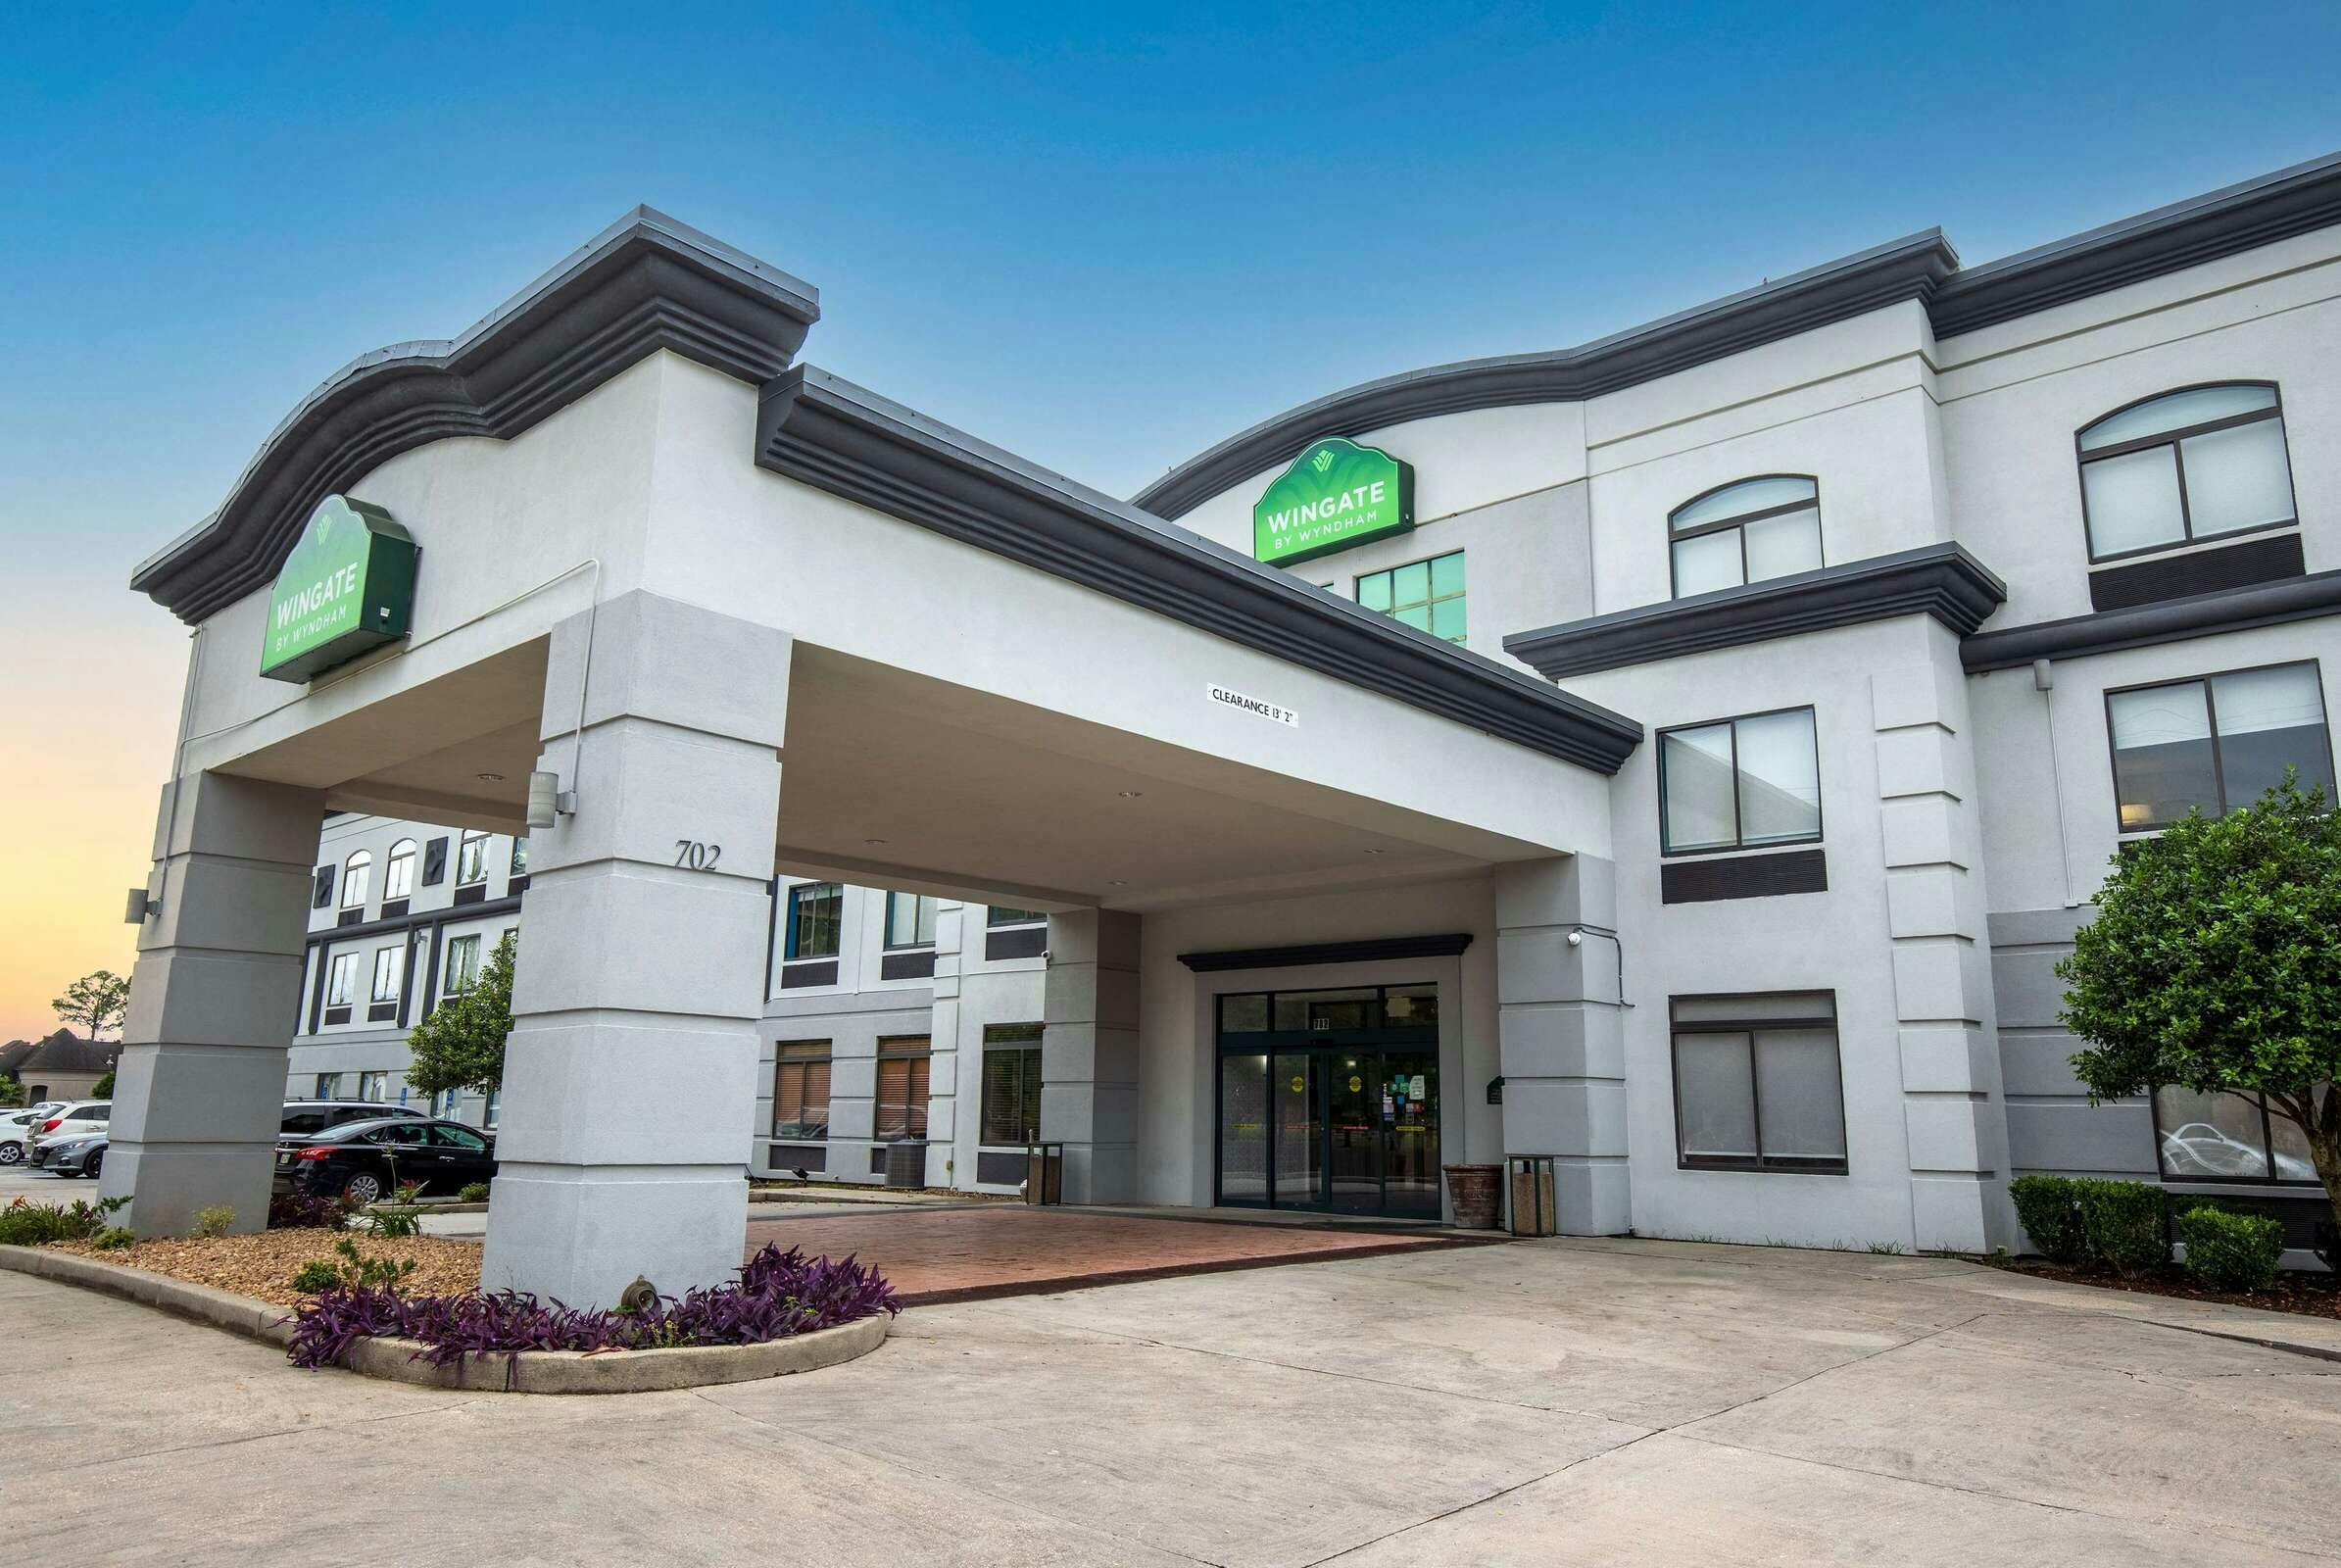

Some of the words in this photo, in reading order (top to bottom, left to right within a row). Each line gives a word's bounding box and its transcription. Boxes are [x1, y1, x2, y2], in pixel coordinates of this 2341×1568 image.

[1267, 480, 1385, 534] WINGATE
[1275, 535, 1292, 550] BY
[1298, 509, 1378, 542] WYNDHAM
[277, 562, 358, 629] WINGATE
[275, 633, 289, 652] BY
[293, 604, 346, 644] WYNDHAM
[1212, 688, 1269, 716] CLEARANCE
[674, 840, 721, 871] 702
